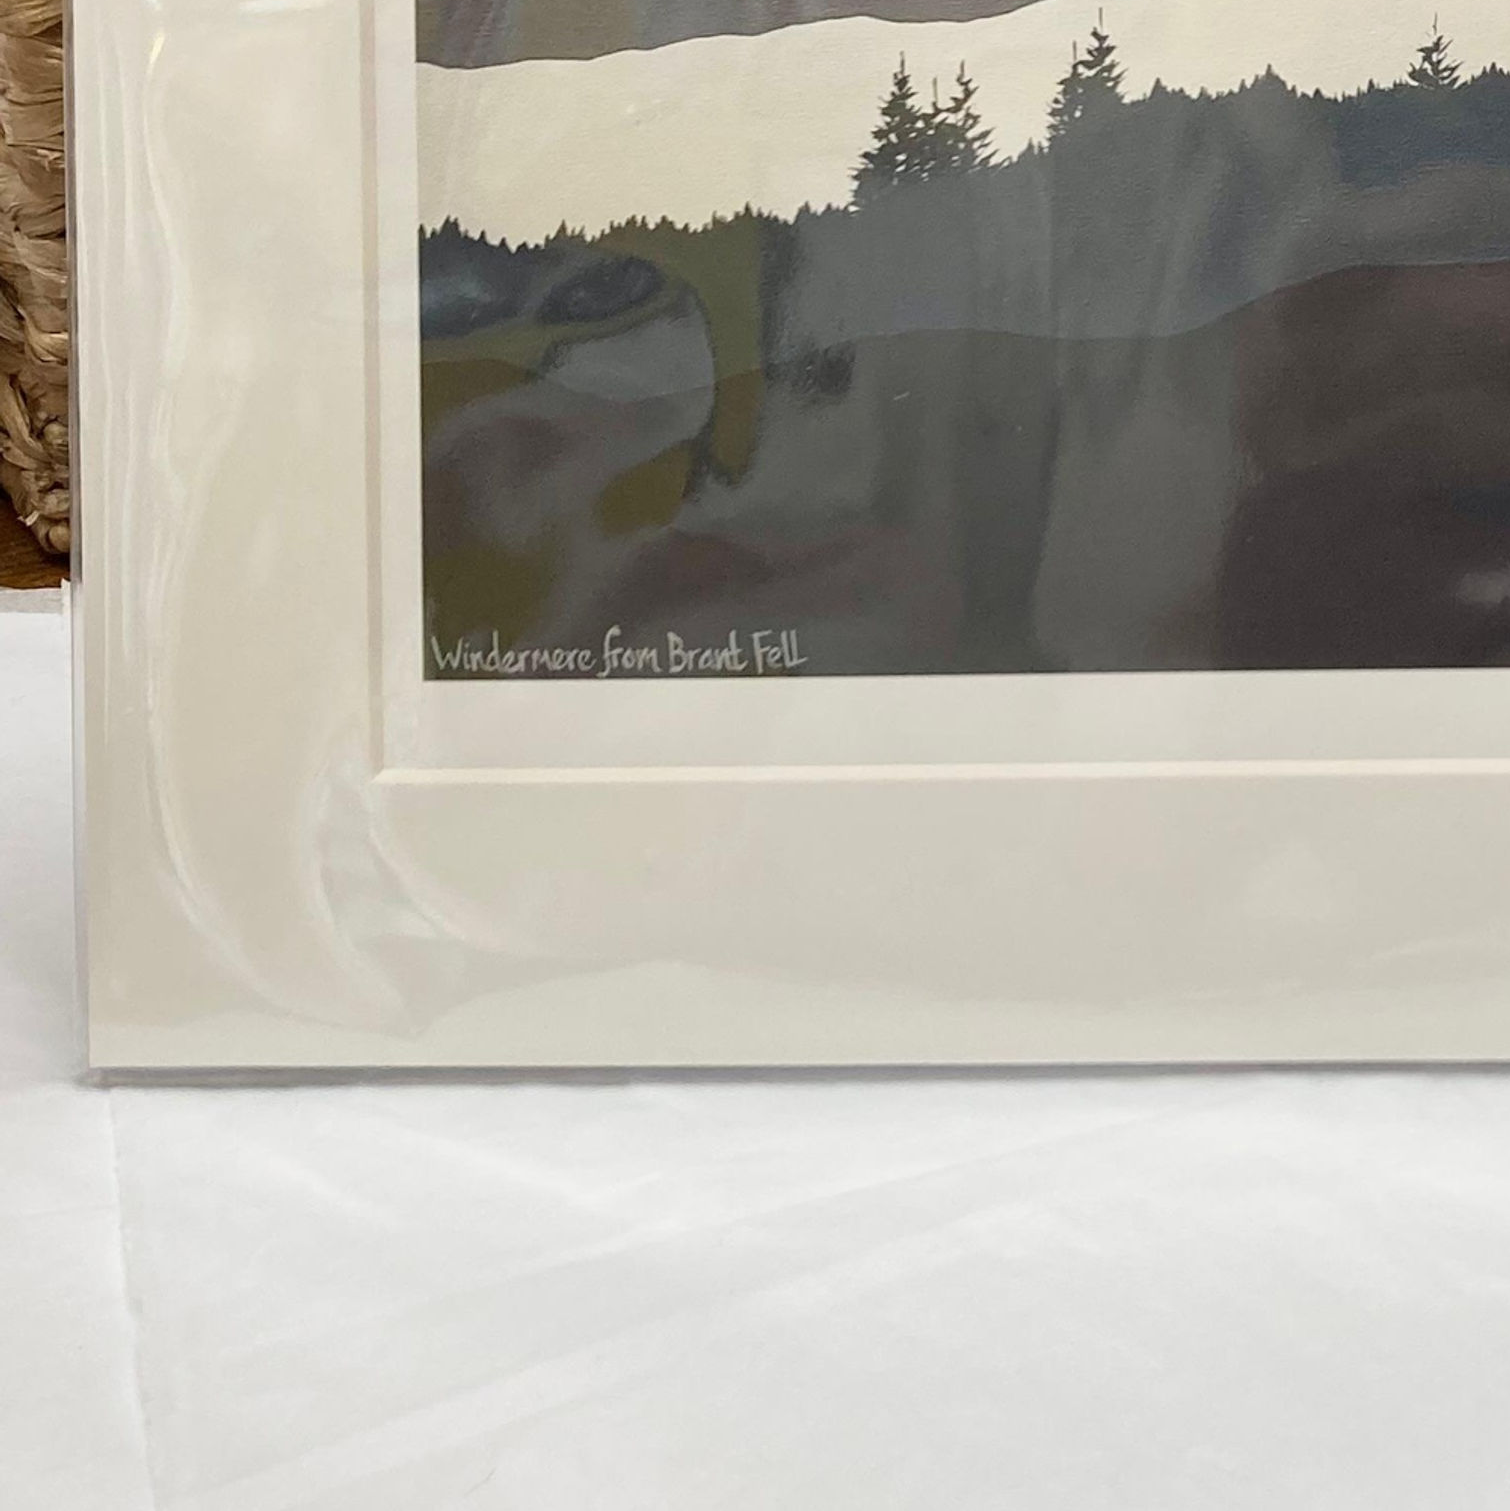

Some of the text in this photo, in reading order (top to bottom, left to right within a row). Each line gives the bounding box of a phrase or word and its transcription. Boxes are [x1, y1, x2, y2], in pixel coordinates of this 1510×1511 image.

[430, 624, 808, 678] Windermere from Brant Fell
